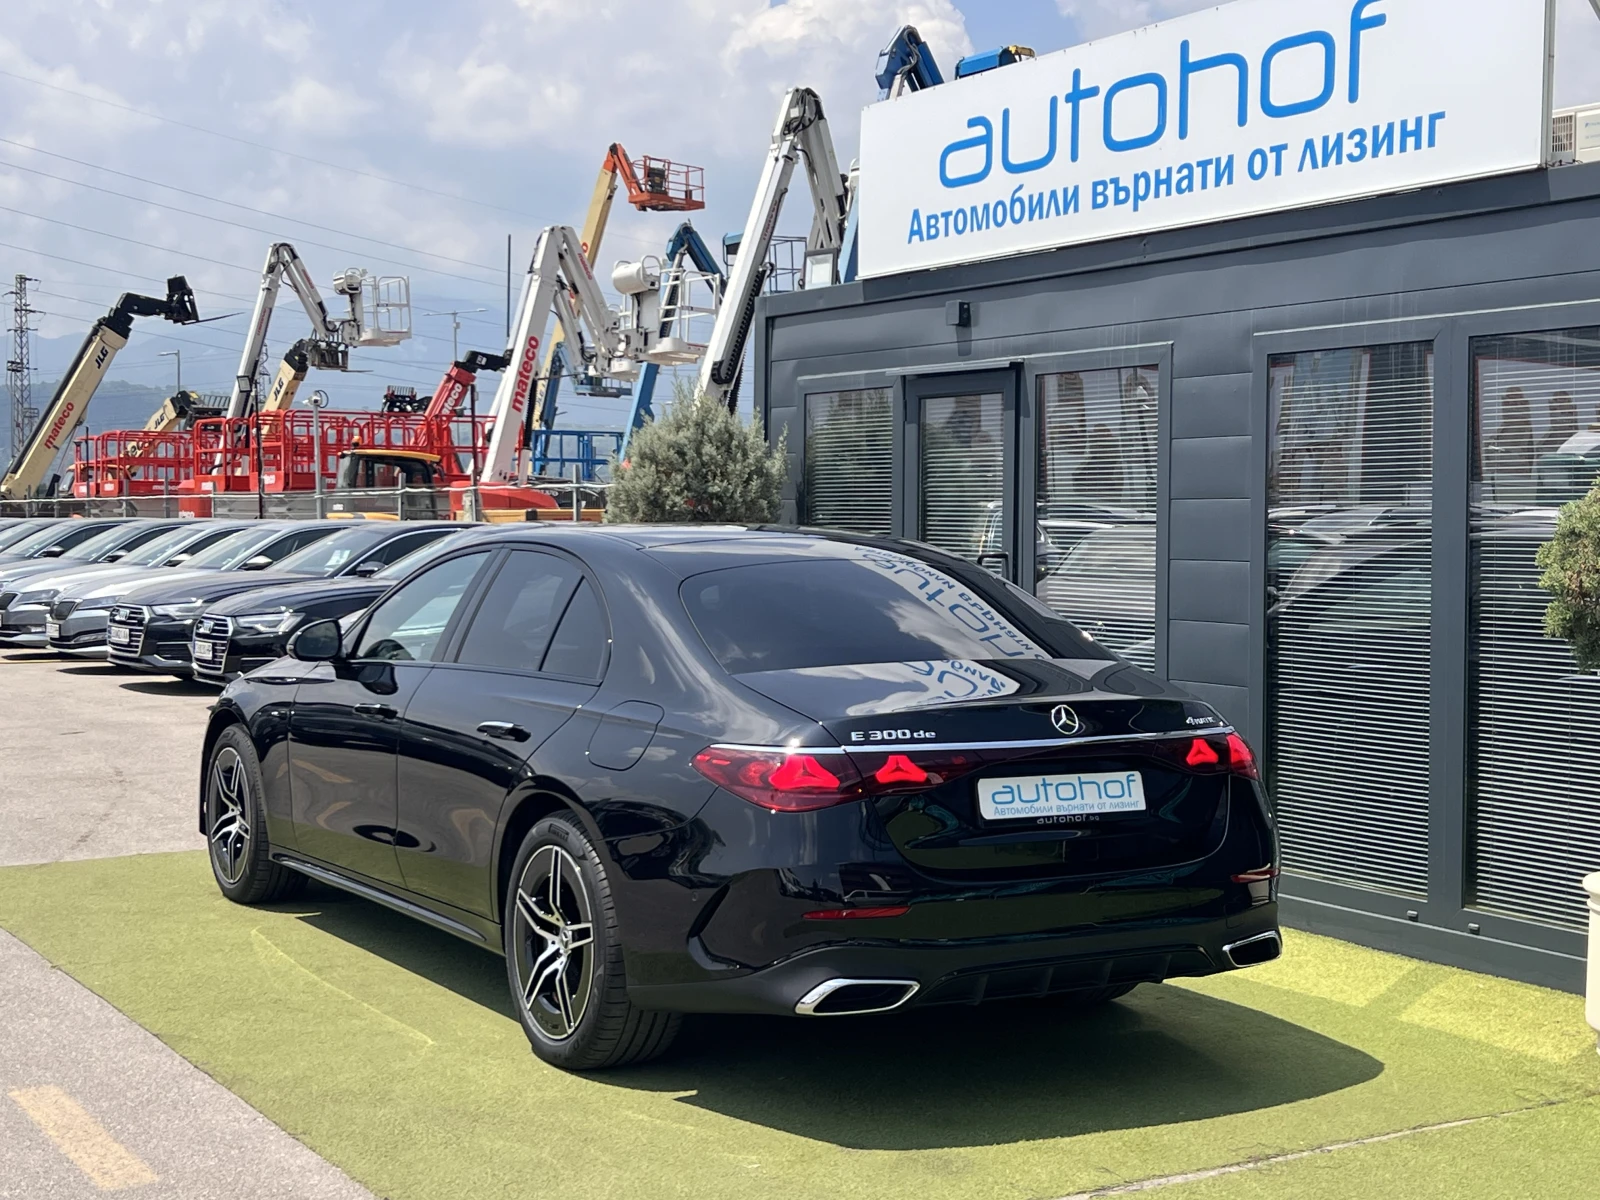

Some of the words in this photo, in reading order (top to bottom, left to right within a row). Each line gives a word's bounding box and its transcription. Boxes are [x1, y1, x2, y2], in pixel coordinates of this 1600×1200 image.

[939, 0, 1387, 189] autohof
[908, 183, 1080, 244] Автомобили
[1092, 153, 1235, 213] върнати
[1247, 143, 1289, 181] от
[1298, 111, 1447, 173] лизинг
[95, 346, 109, 370] JLG
[274, 377, 285, 402] JLG
[511, 335, 540, 414] mateco
[441, 383, 463, 416] ateco
[44, 402, 75, 450] mateco
[850, 731, 866, 741] E
[991, 773, 1137, 805] autohof
[993, 804, 1054, 817] Автомобили
[1056, 802, 1095, 814] върнати
[1096, 802, 1107, 811] от
[1108, 800, 1140, 809] лизинг
